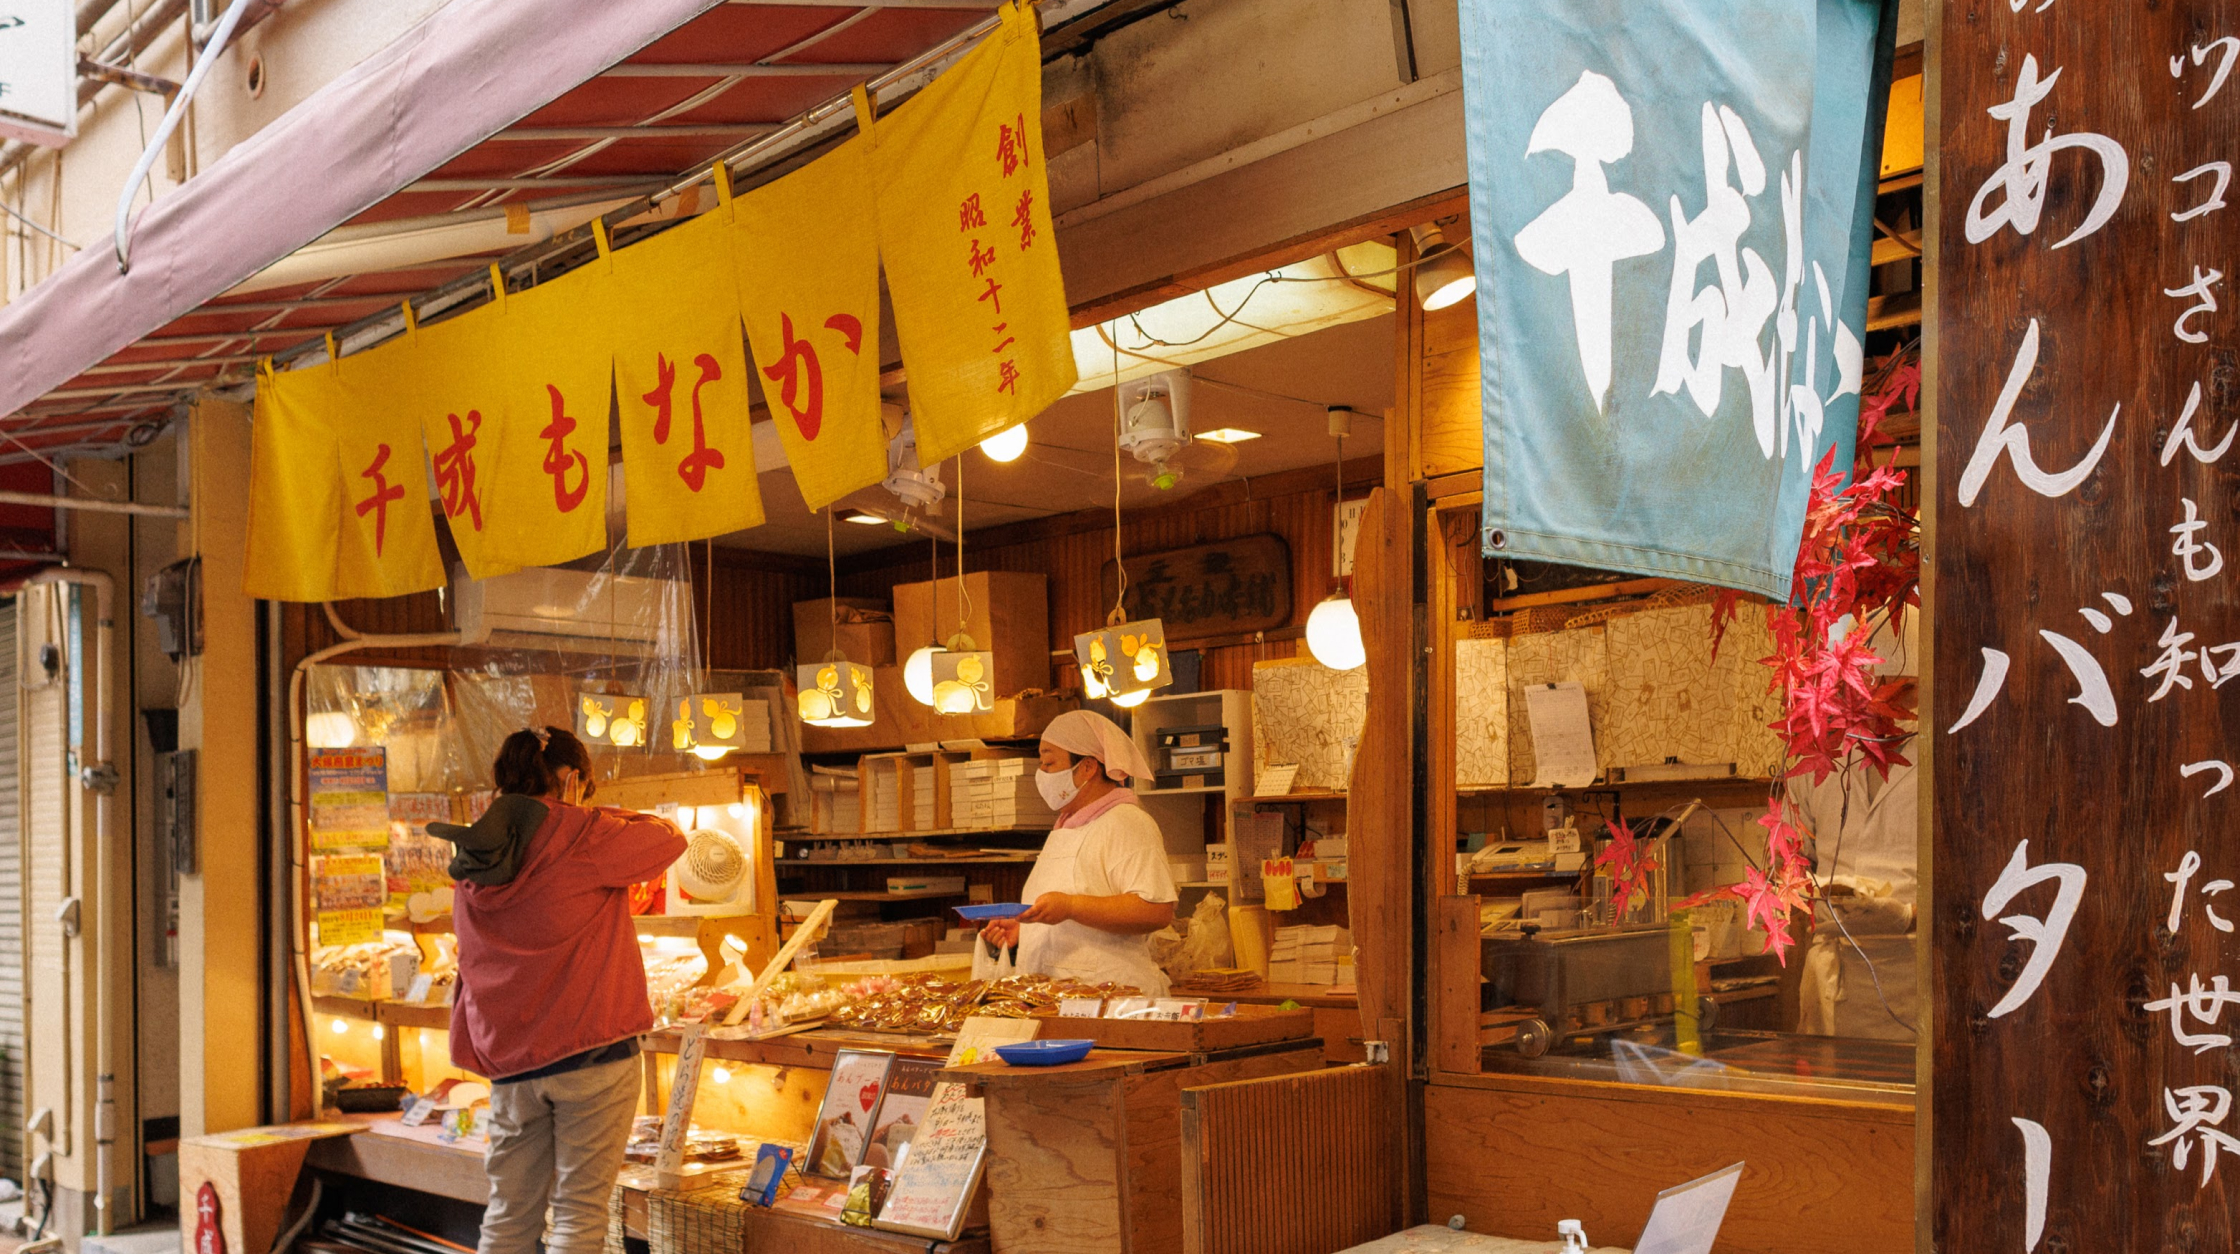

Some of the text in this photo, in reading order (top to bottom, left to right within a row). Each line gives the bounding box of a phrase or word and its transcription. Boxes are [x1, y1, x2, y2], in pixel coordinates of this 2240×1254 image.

[995, 112, 1036, 253] 創業
[958, 192, 1021, 397] 昭和十二年
[1948, 0, 2134, 1254] あんバター
[1181, 756, 1207, 766] ゴマ塩
